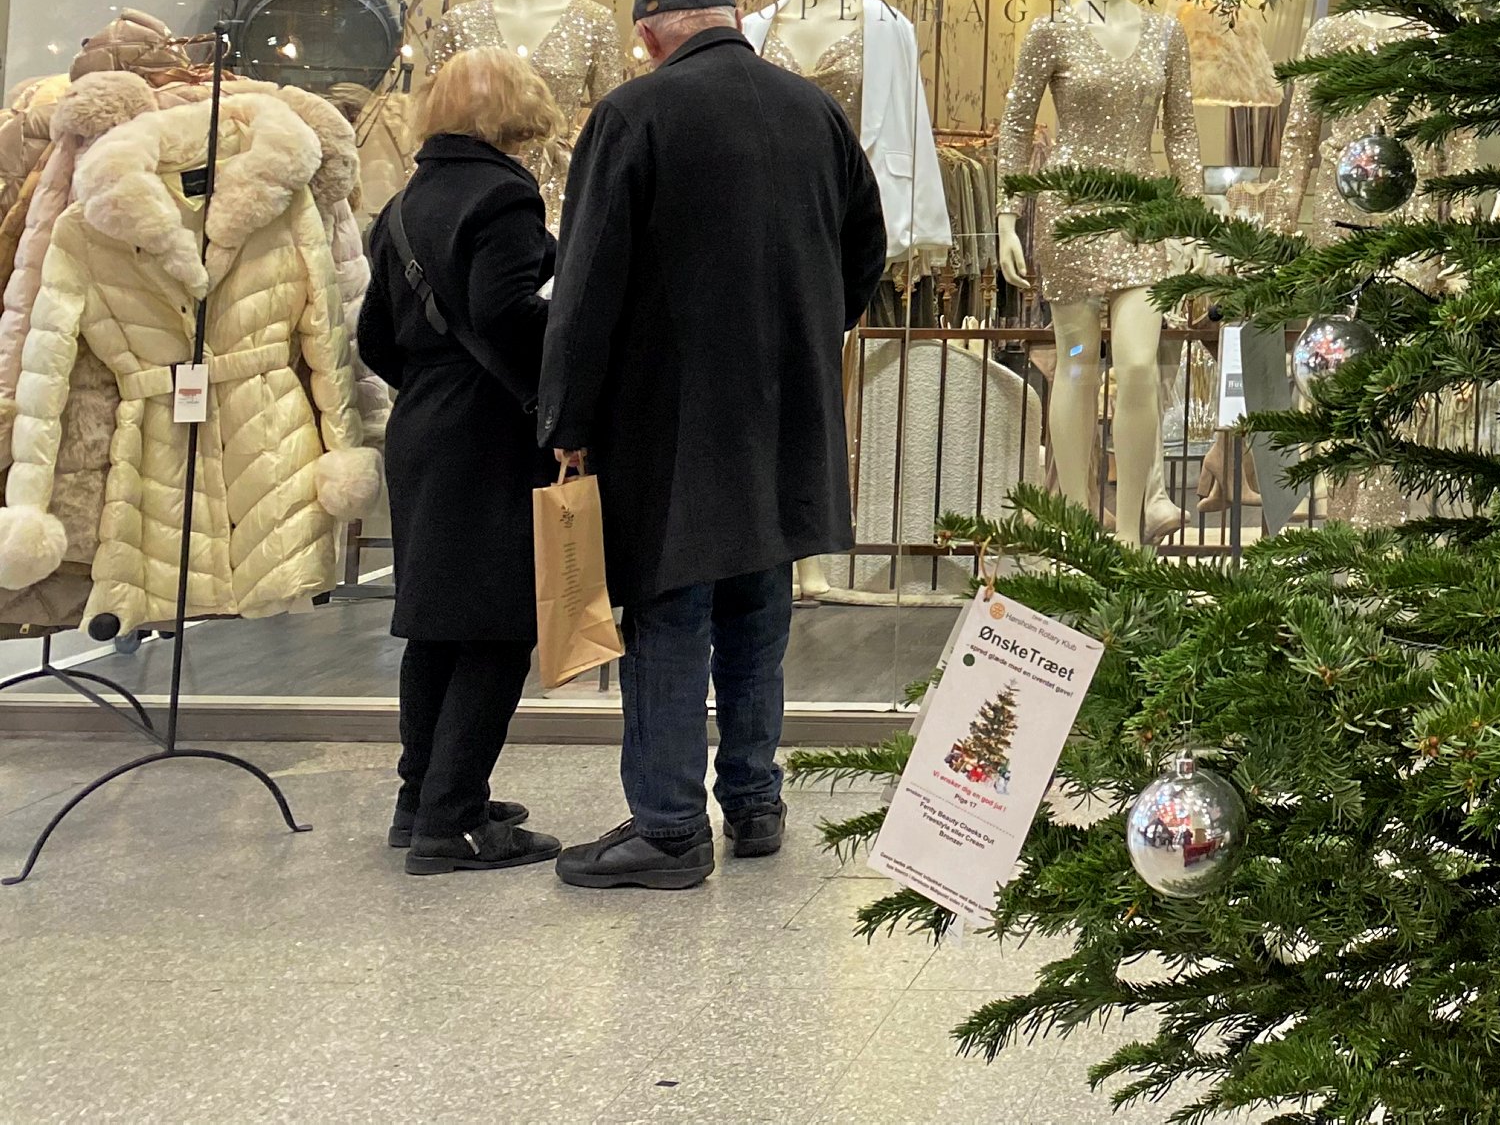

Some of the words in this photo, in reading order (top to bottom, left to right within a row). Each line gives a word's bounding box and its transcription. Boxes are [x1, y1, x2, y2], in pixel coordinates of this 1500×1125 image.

[1005, 612, 1037, 632] Hørsholm
[1038, 628, 1061, 645] Rotary
[1061, 639, 1077, 651] Klub
[970, 644, 988, 656] spred
[1008, 662, 1022, 673] med
[1023, 669, 1031, 677] en
[978, 625, 1075, 681] ØnskeTræet
[962, 785, 972, 796] dig
[981, 796, 993, 806] god
[993, 802, 1003, 811] jul
[938, 811, 959, 826] Beauty
[983, 834, 995, 845] Out
[939, 830, 963, 846] Bronzer
[965, 834, 984, 849] Cream
